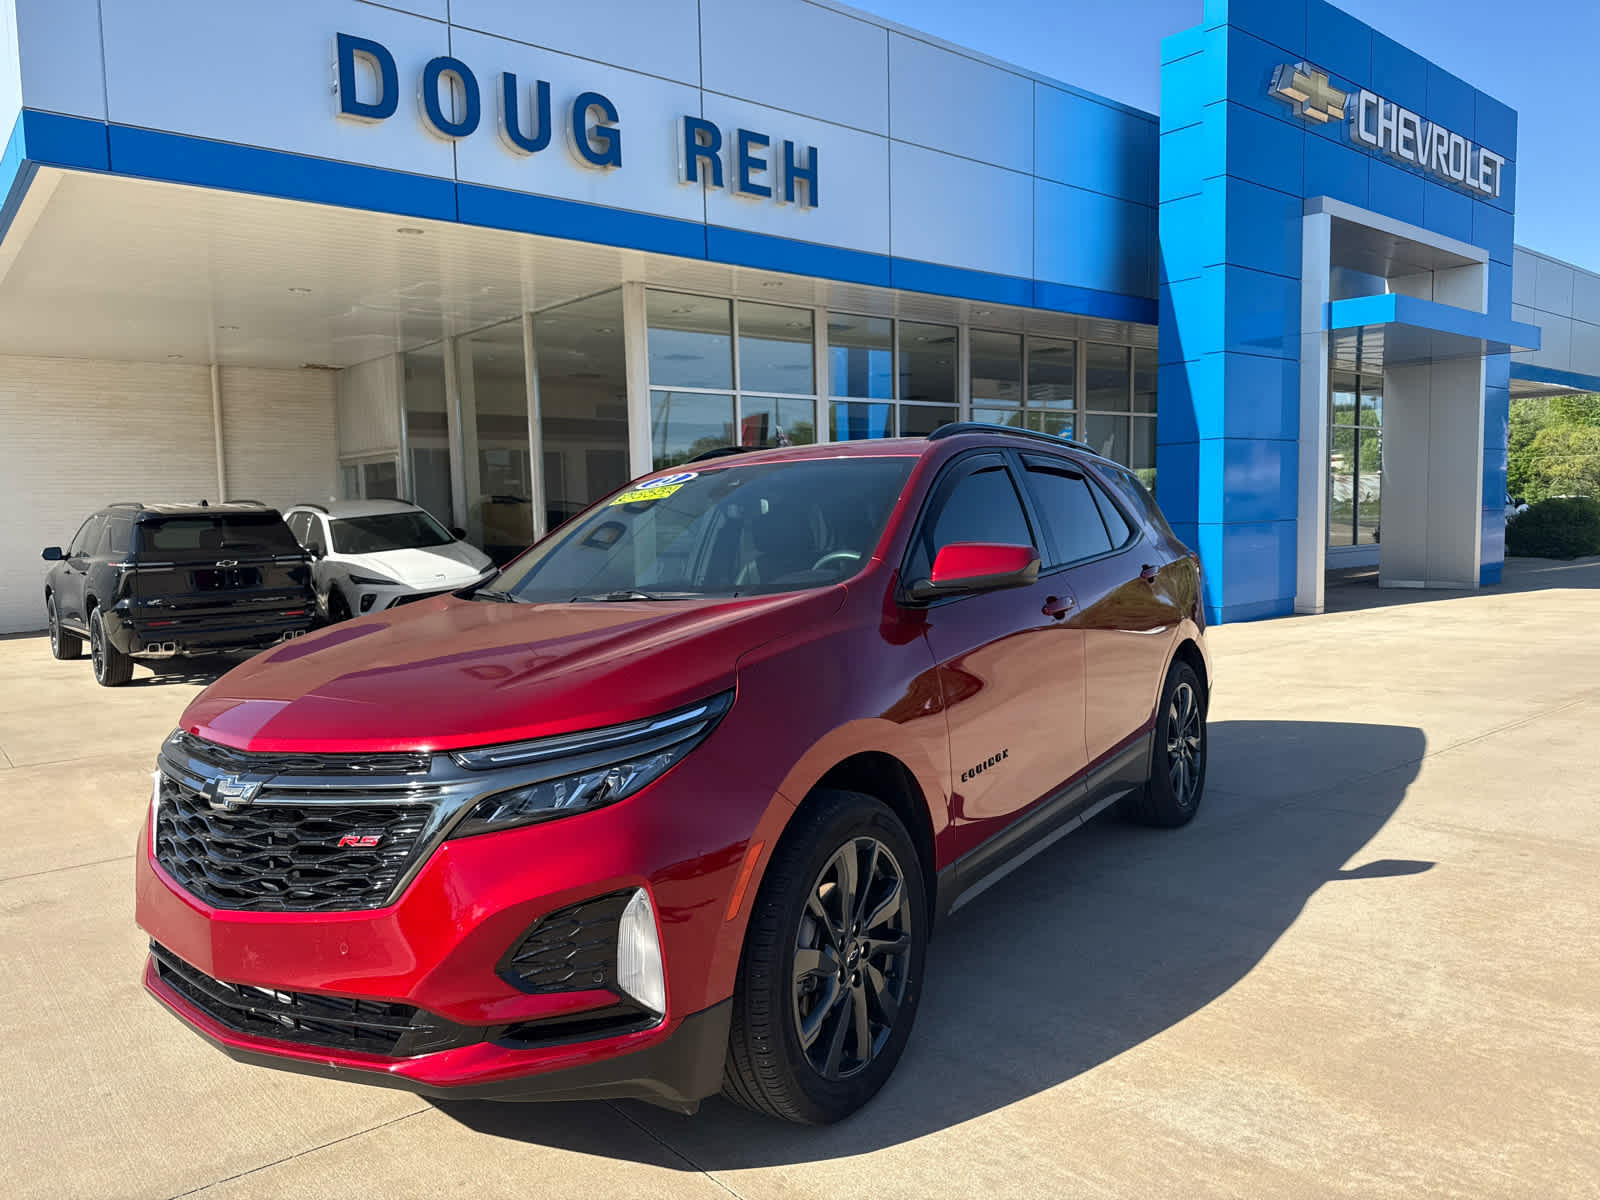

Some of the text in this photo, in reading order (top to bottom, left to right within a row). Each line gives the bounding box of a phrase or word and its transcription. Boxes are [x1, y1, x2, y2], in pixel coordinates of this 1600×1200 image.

[334, 32, 819, 209] DOUG REH
[1356, 88, 1505, 198] CHEVROLET
[961, 748, 1009, 783] EQUINOX
[337, 835, 383, 847] RS
